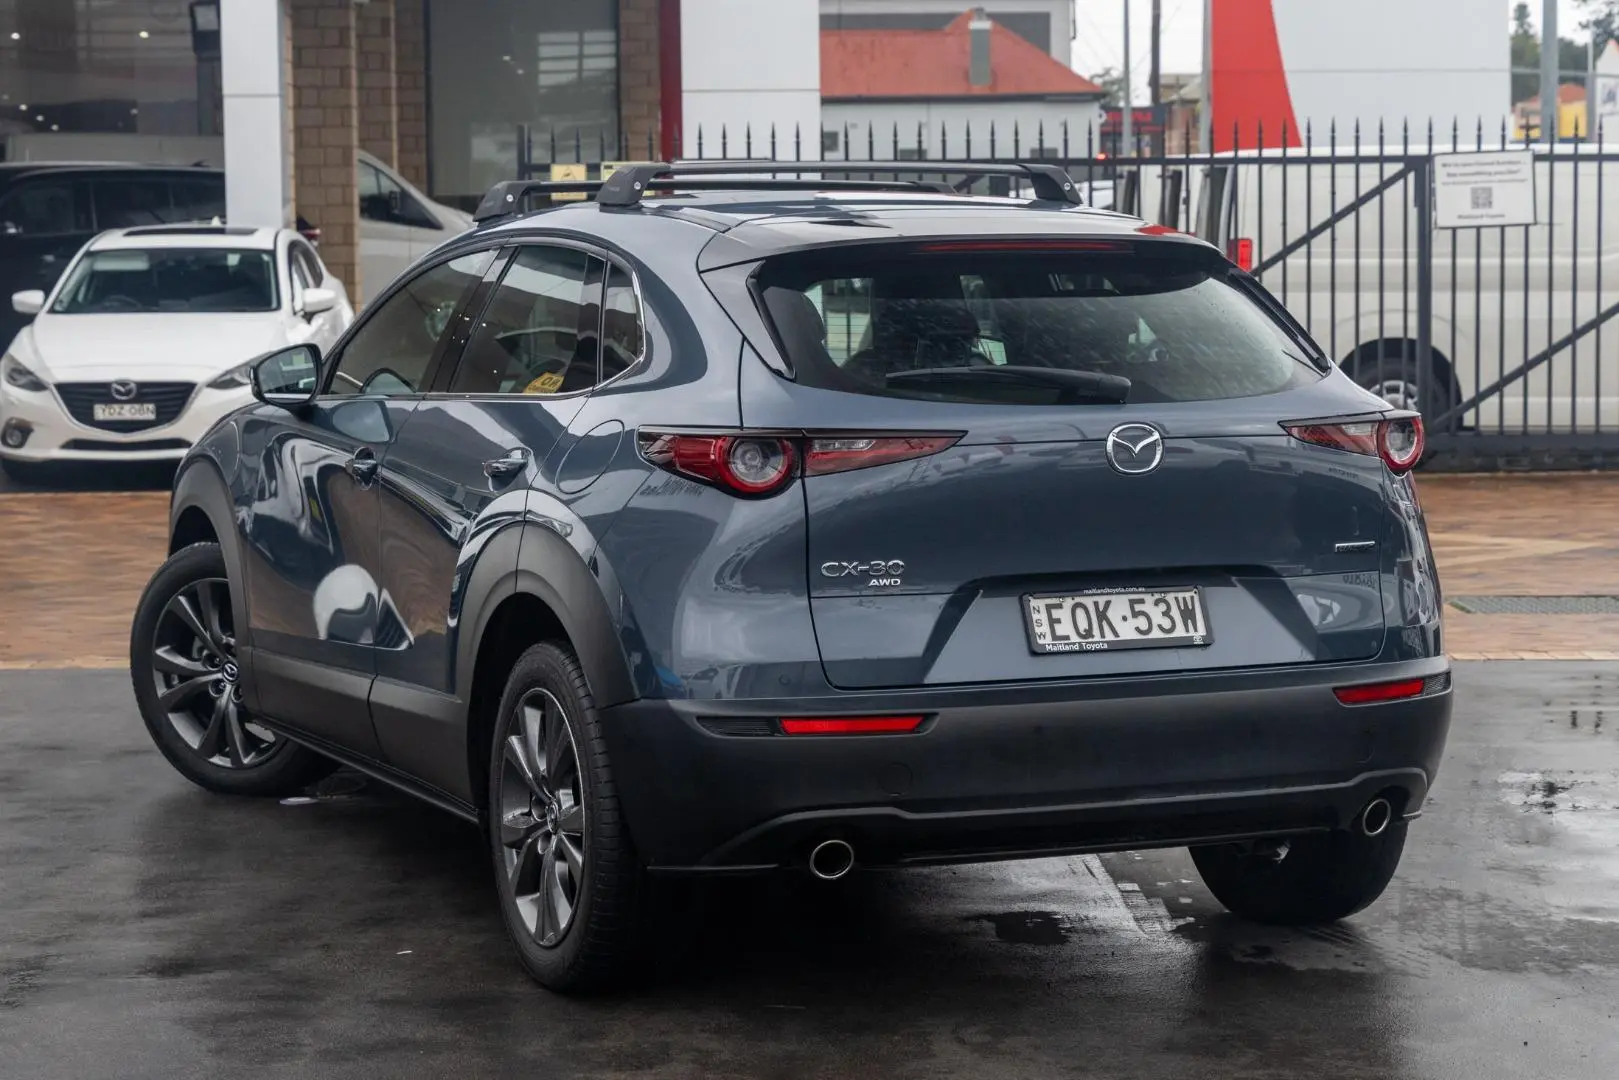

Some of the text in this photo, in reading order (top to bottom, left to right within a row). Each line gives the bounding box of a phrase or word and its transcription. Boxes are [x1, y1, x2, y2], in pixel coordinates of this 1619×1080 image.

[821, 559, 905, 577] CX-30
[868, 578, 901, 587] AWD
[1046, 642, 1108, 652] Maitland Toyota
